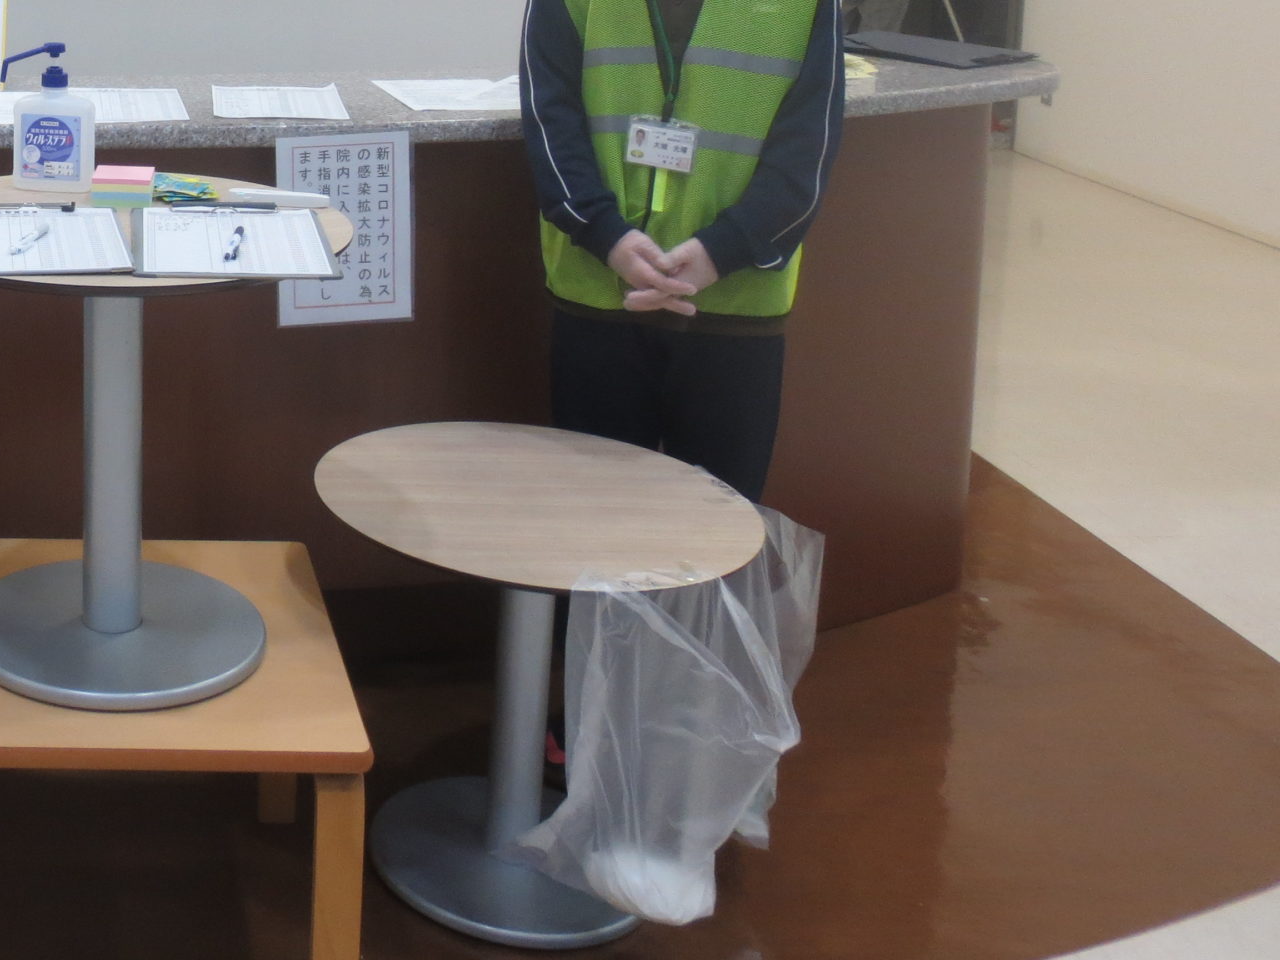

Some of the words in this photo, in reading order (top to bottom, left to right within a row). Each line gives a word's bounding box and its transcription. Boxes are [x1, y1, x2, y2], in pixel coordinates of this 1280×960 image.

[298, 151, 313, 188] ます。
[376, 147, 391, 297] 新型コロナウィルス
